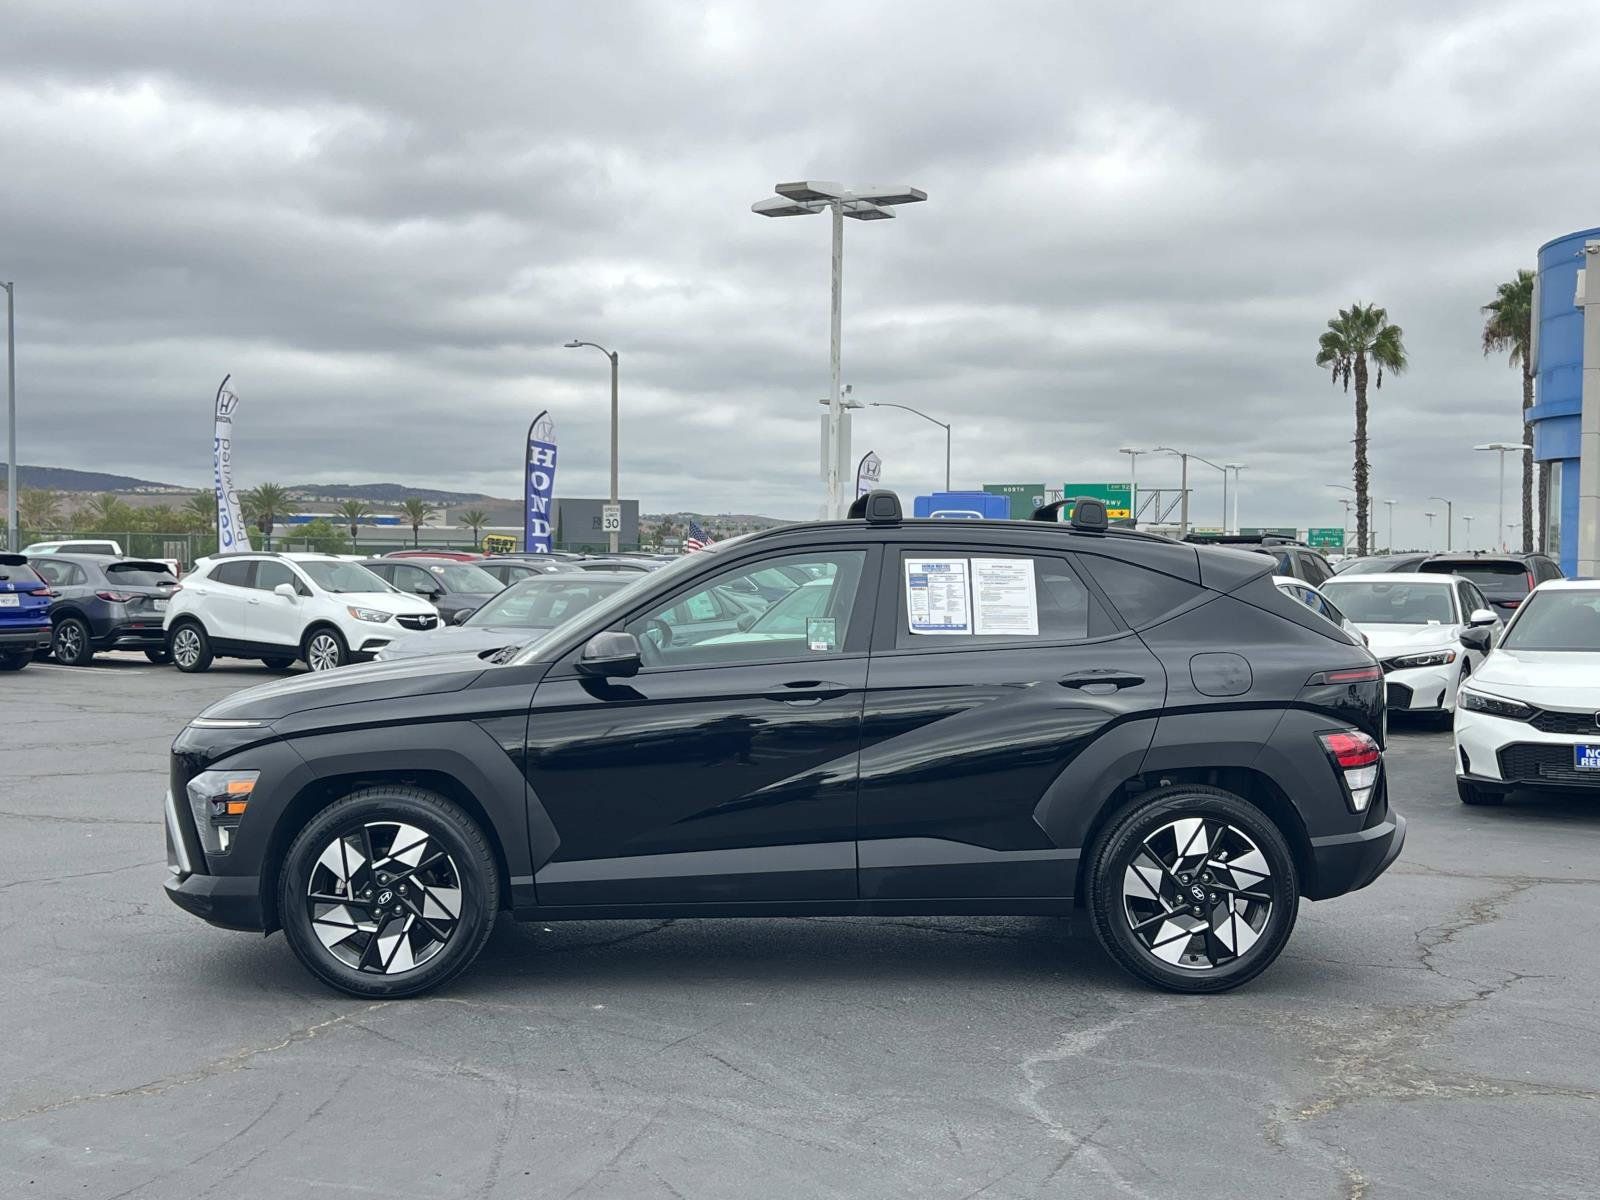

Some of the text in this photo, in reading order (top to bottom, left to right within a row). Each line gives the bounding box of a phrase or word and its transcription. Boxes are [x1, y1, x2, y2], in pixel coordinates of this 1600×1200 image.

[529, 445, 556, 553] HONDA
[604, 518, 619, 528] 30
[488, 537, 514, 547] BEST
